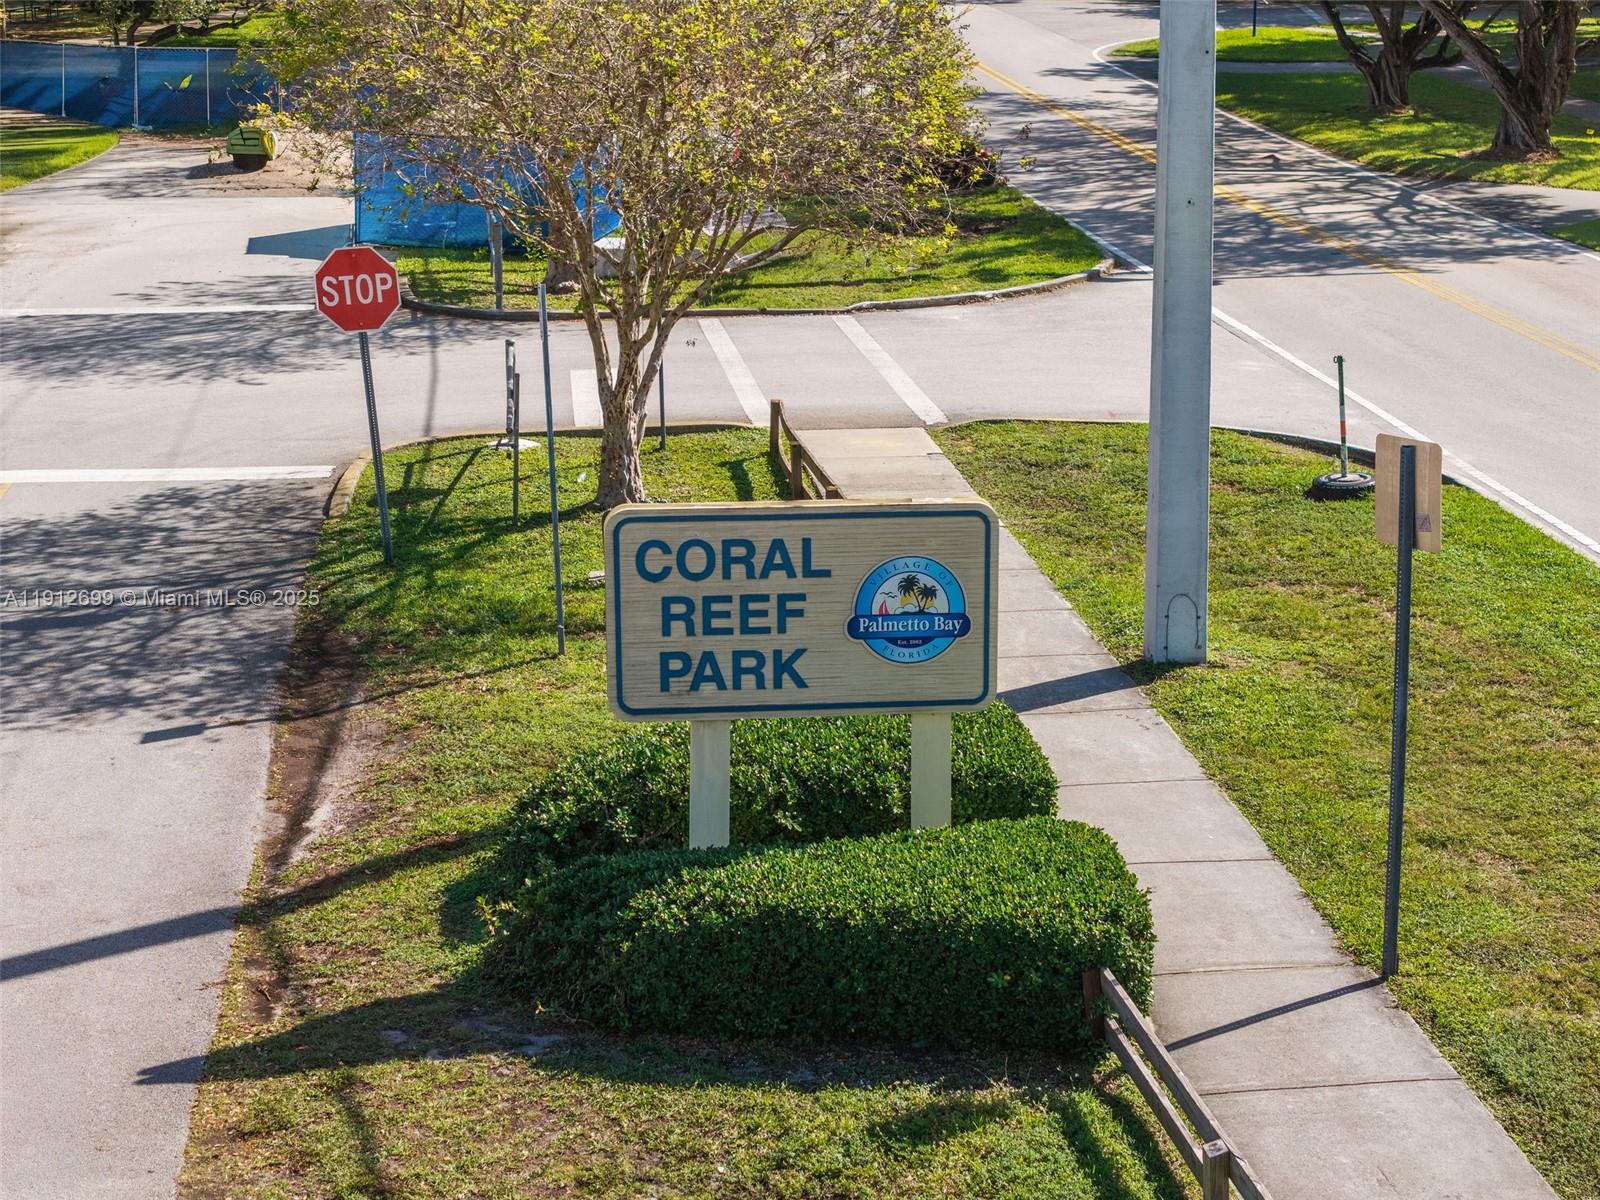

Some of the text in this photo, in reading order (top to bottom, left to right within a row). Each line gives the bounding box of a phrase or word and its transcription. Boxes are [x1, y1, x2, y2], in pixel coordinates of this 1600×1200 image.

[322, 273, 392, 307] STOP
[635, 537, 832, 582] CORAL
[869, 561, 955, 586] VILLAGE OF
[661, 593, 807, 636] REEF
[859, 616, 962, 633] Palmetto Bay
[881, 643, 940, 659] FLORIDA
[659, 648, 809, 693] PARK
